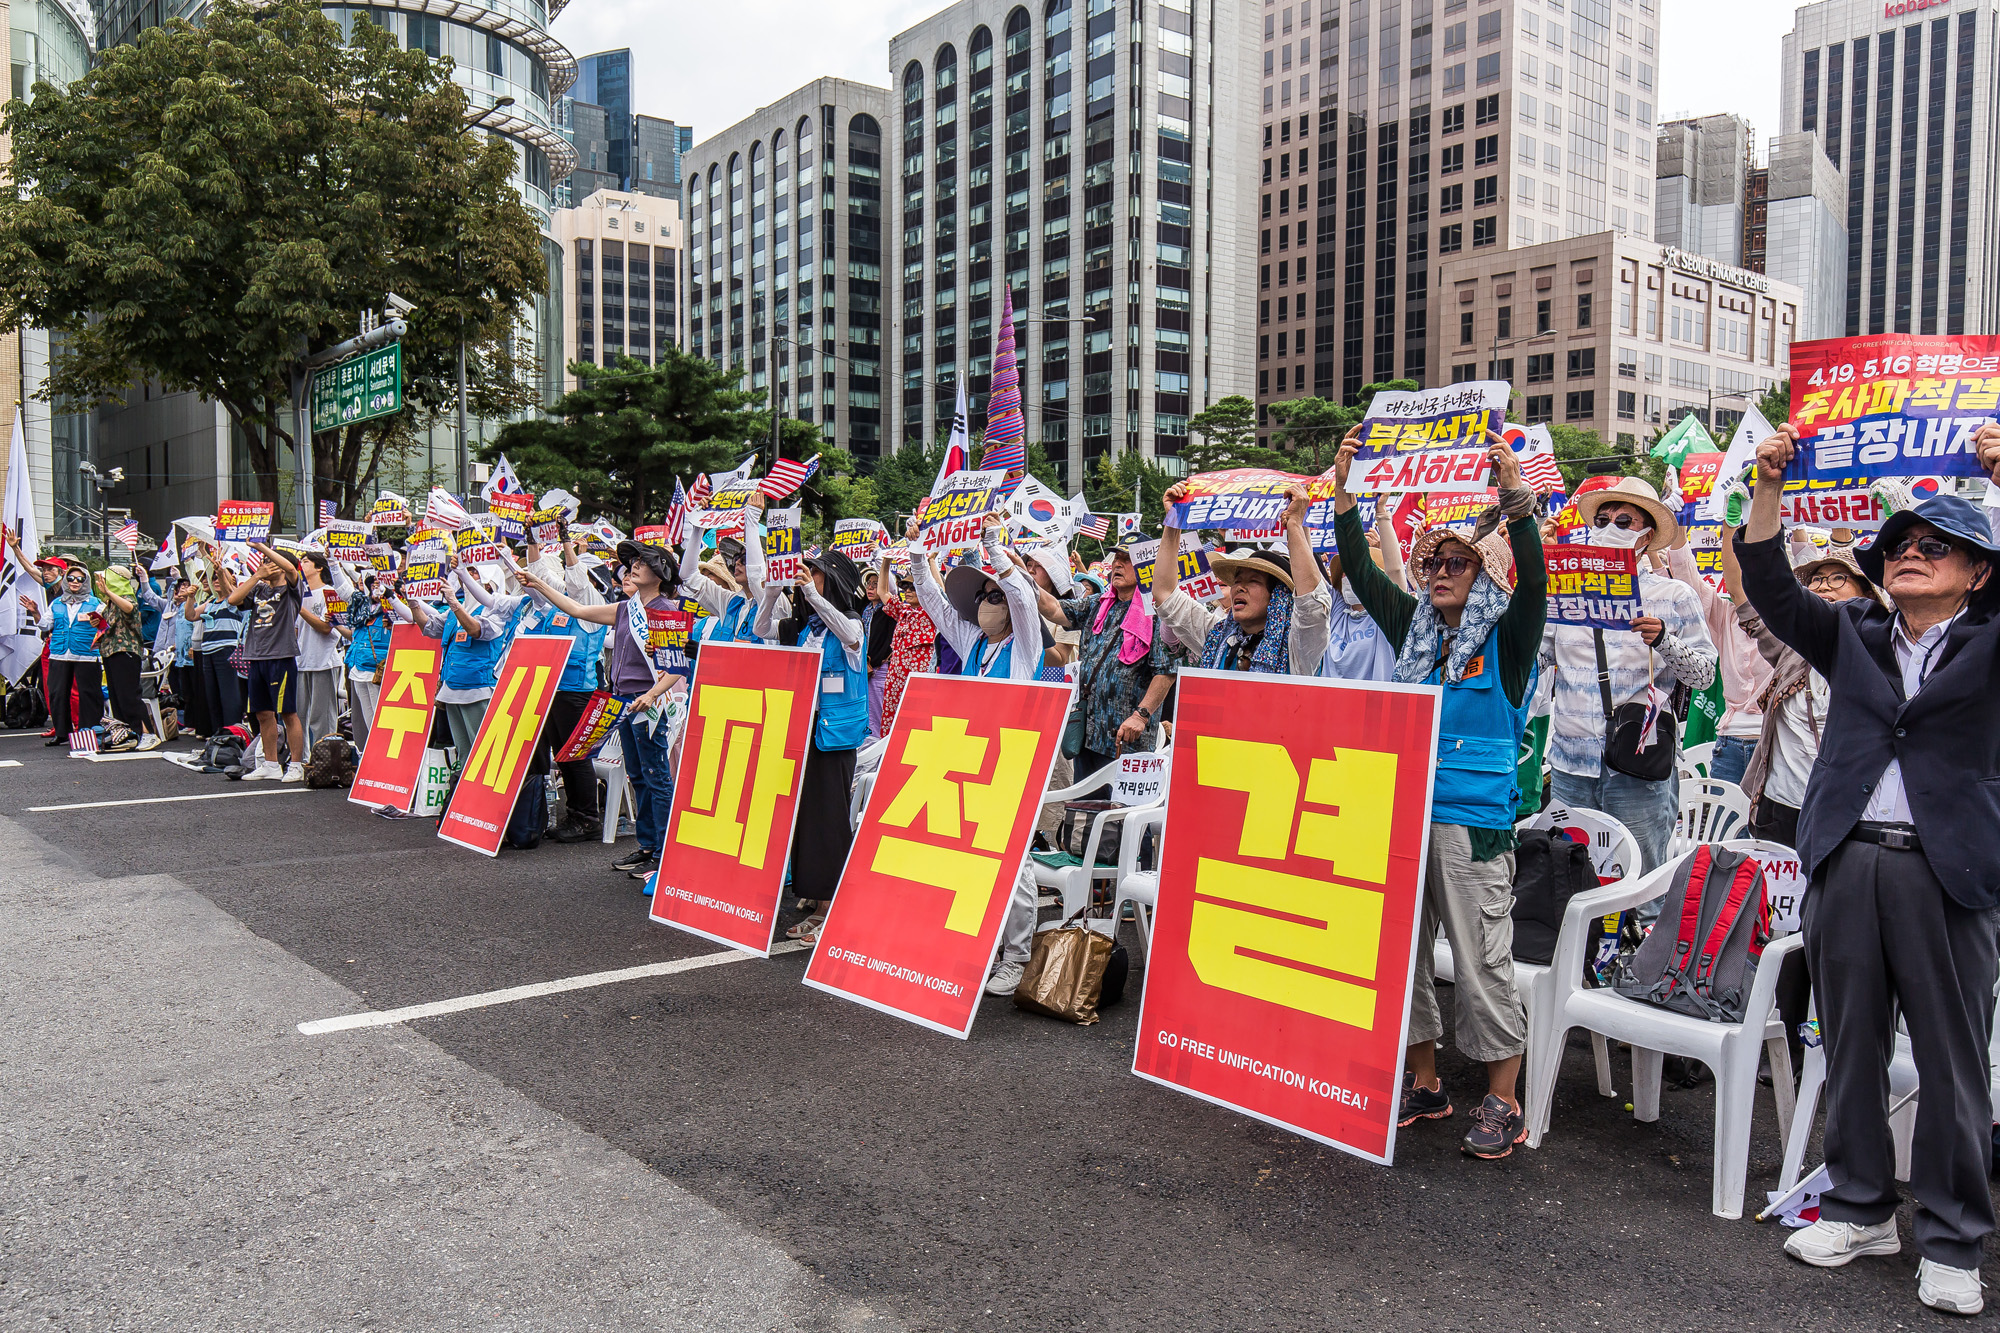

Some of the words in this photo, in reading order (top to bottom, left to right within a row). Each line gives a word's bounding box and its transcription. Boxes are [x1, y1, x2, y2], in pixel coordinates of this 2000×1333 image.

[1681, 254, 1709, 275] SEOUL
[1710, 261, 1744, 286] FINANCE
[1745, 273, 1771, 292] CENTER
[1879, 340, 1924, 348] UNIFICATION
[341, 362, 364, 385] 종로1가
[370, 353, 395, 378] 서대문역
[1807, 363, 1855, 387] 4.19,
[1863, 355, 1911, 378] 5.16
[1916, 354, 1999, 375] 혁명으로
[1386, 396, 1439, 416] 대한민국
[1440, 389, 1486, 411] 무너졌다
[1797, 377, 2000, 424] 주사파척결
[1365, 410, 1490, 452] 부정선거
[1364, 453, 1492, 489] 수사하라
[1689, 463, 1717, 474] 4.19,
[1186, 479, 1297, 495] 주사파척결
[1451, 495, 1472, 505] 5.16
[1472, 493, 1500, 504] 혁명으
[924, 488, 992, 524] 부정선거
[1187, 495, 1289, 524] 끝장내자
[1425, 503, 1490, 525] 주사파척
[220, 514, 270, 526] 주사파척결
[225, 526, 269, 539] 끝장내자
[330, 532, 367, 547] 부정선거
[767, 528, 793, 555] 선거
[834, 529, 873, 546] 부정선거
[840, 546, 873, 560] 사하라
[1548, 558, 1579, 571] 5.16
[1580, 557, 1626, 571] 혁명으로
[407, 562, 439, 581] 부정선거
[767, 558, 802, 582] 하라
[407, 582, 441, 598] 수사하라
[1547, 572, 1632, 596] 사파척결
[327, 602, 349, 613] 주사파
[665, 619, 686, 630] 혁명으로
[377, 649, 435, 760] 주
[464, 666, 551, 794] 사
[579, 726, 593, 742] 5.16
[588, 697, 607, 725] 혁명으로
[675, 684, 796, 869] 파
[870, 715, 1041, 937] 척
[1188, 735, 1398, 1031] 결
[665, 885, 675, 897] GO
[676, 888, 693, 902] FREE
[693, 893, 735, 915] UNIFICATION
[735, 906, 764, 924] KOREA!
[828, 946, 842, 959] GO
[842, 950, 867, 967] FREE
[867, 957, 924, 985] UNIFICATION
[924, 975, 964, 998] KOREA!
[1158, 1030, 1178, 1048] GO
[1180, 1037, 1215, 1060] FREE
[1218, 1048, 1305, 1090] UNIFICATION
[1308, 1078, 1368, 1111] KOREA!
